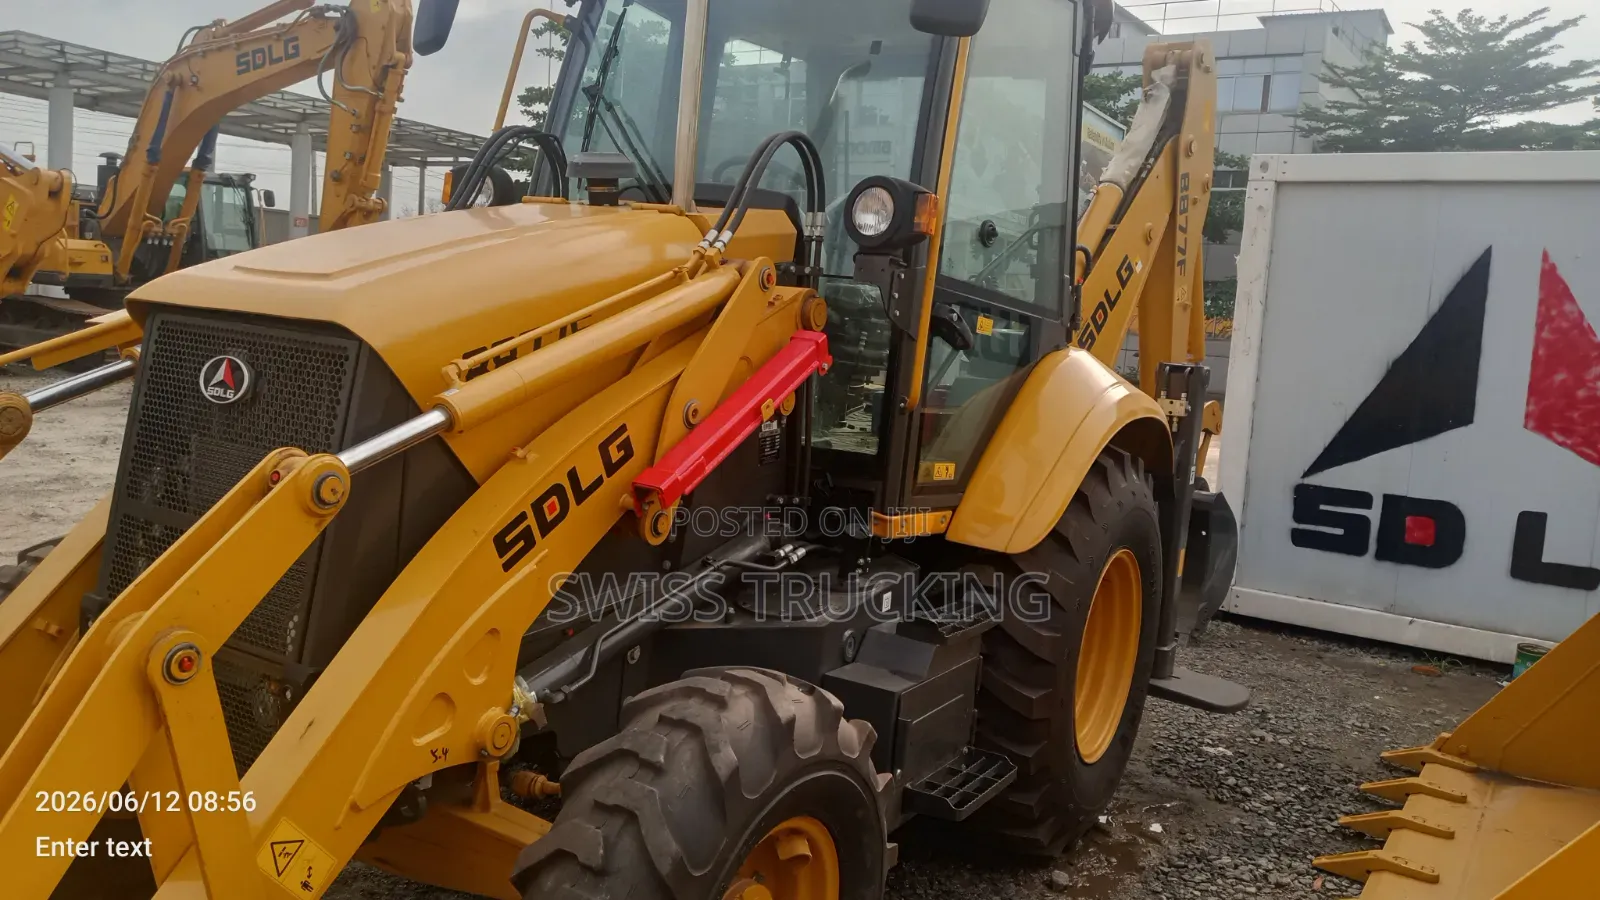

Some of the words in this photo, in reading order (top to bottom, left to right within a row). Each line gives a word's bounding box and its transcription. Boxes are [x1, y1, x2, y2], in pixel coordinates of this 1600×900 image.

[235, 35, 300, 76] SDLG
[1176, 171, 1191, 277] B877F
[1077, 253, 1134, 352] SDLG
[206, 386, 235, 399] SDLG
[492, 422, 635, 573] SDLG
